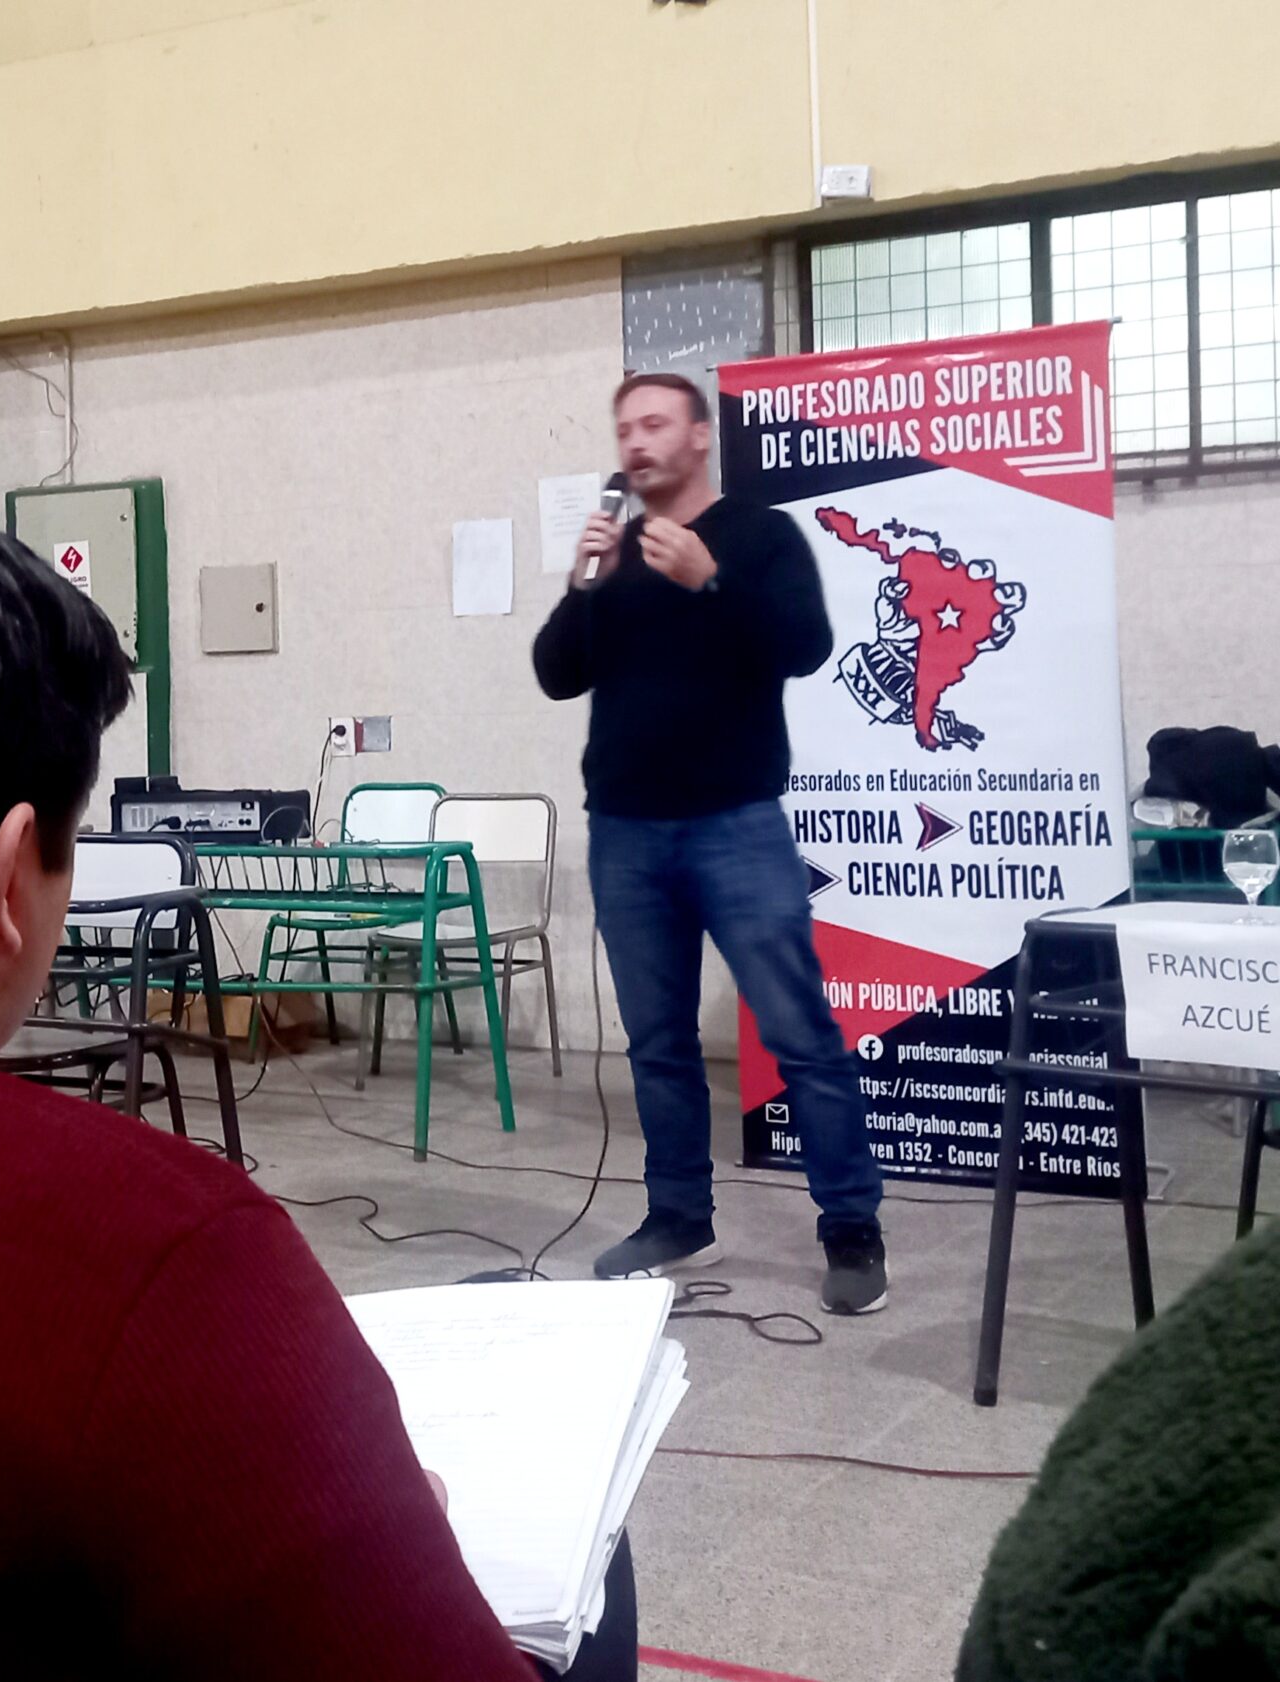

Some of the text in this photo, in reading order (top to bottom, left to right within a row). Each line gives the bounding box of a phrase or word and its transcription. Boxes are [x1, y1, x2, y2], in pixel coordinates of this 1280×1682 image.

[742, 355, 1073, 427] PROFESORADO SUPERIOR
[761, 405, 1064, 470] DE CIENCIAS SOCIALES
[786, 768, 1100, 792] esorados en Educación Secundaria en
[794, 803, 1113, 847] HISTORIA GEOGRAFÍA
[848, 857, 1065, 901] CIENCIA POLÍTICA
[1147, 953, 1279, 984] FRANCISC
[858, 978, 943, 1018] PÚBLICA,
[948, 986, 1003, 1017] LIBRE
[1182, 1004, 1272, 1034] AZCUÉ
[865, 1111, 1118, 1147] ctoria@yahoo.com.a 345) 421-423
[771, 1131, 802, 1156] Hipó
[898, 1141, 932, 1162] 1352
[1039, 1152, 1082, 1175] Entre
[1086, 1156, 1121, 1178] Ríos
